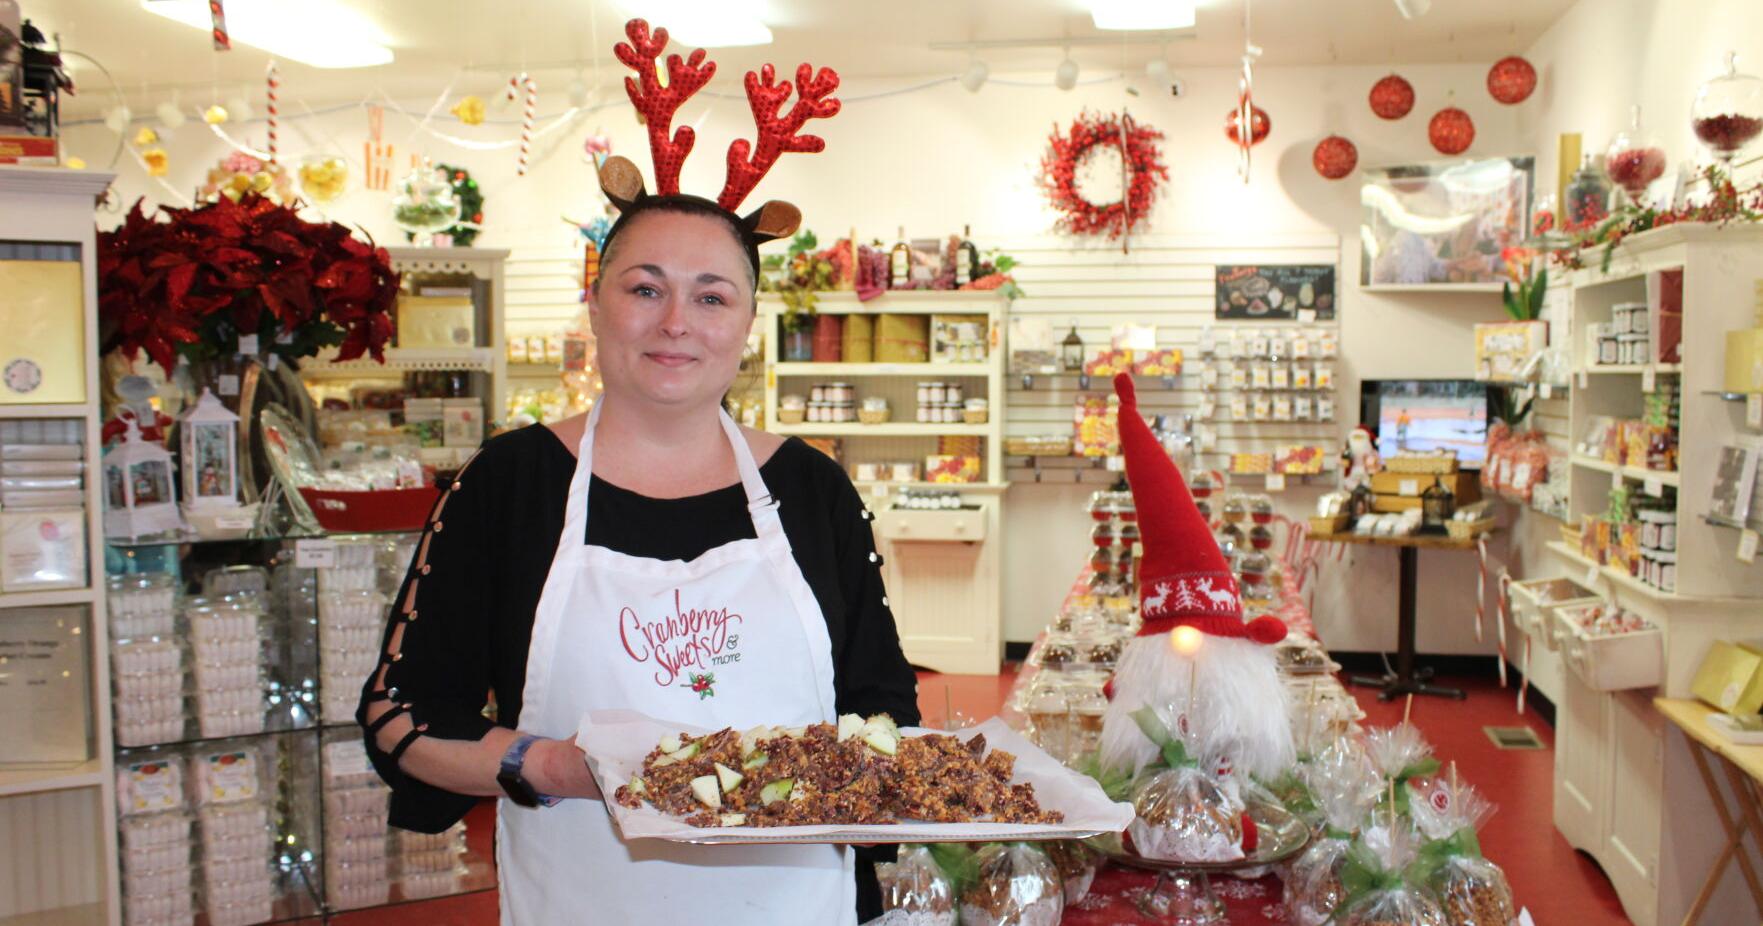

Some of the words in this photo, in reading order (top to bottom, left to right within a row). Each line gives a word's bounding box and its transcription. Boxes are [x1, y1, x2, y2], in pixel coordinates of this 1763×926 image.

[619, 588, 743, 662] Cranberry
[655, 634, 711, 686] Sweets
[726, 634, 739, 650] &
[712, 652, 741, 666] more
